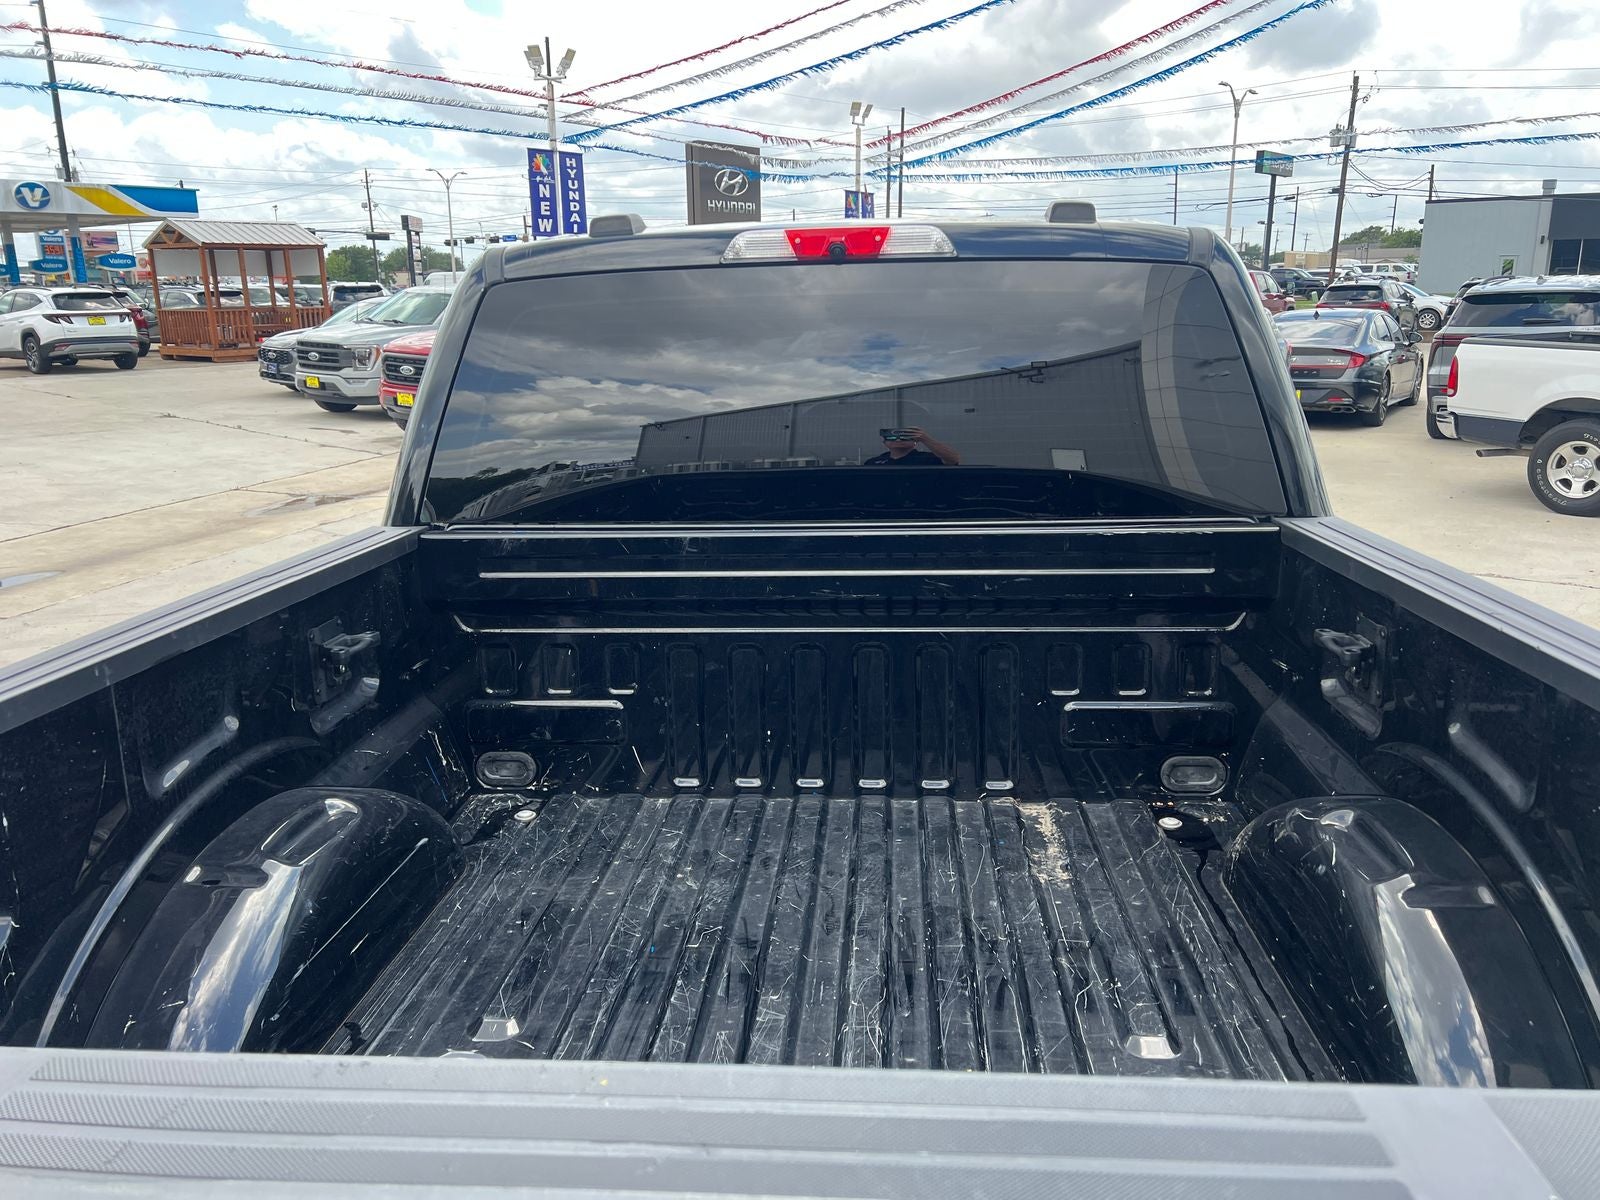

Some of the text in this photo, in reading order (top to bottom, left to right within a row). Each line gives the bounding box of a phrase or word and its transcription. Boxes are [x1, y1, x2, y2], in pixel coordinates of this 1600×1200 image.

[537, 183, 553, 232] NEW
[565, 157, 581, 233] HYUNDAI
[707, 199, 756, 215] HYUNDAI
